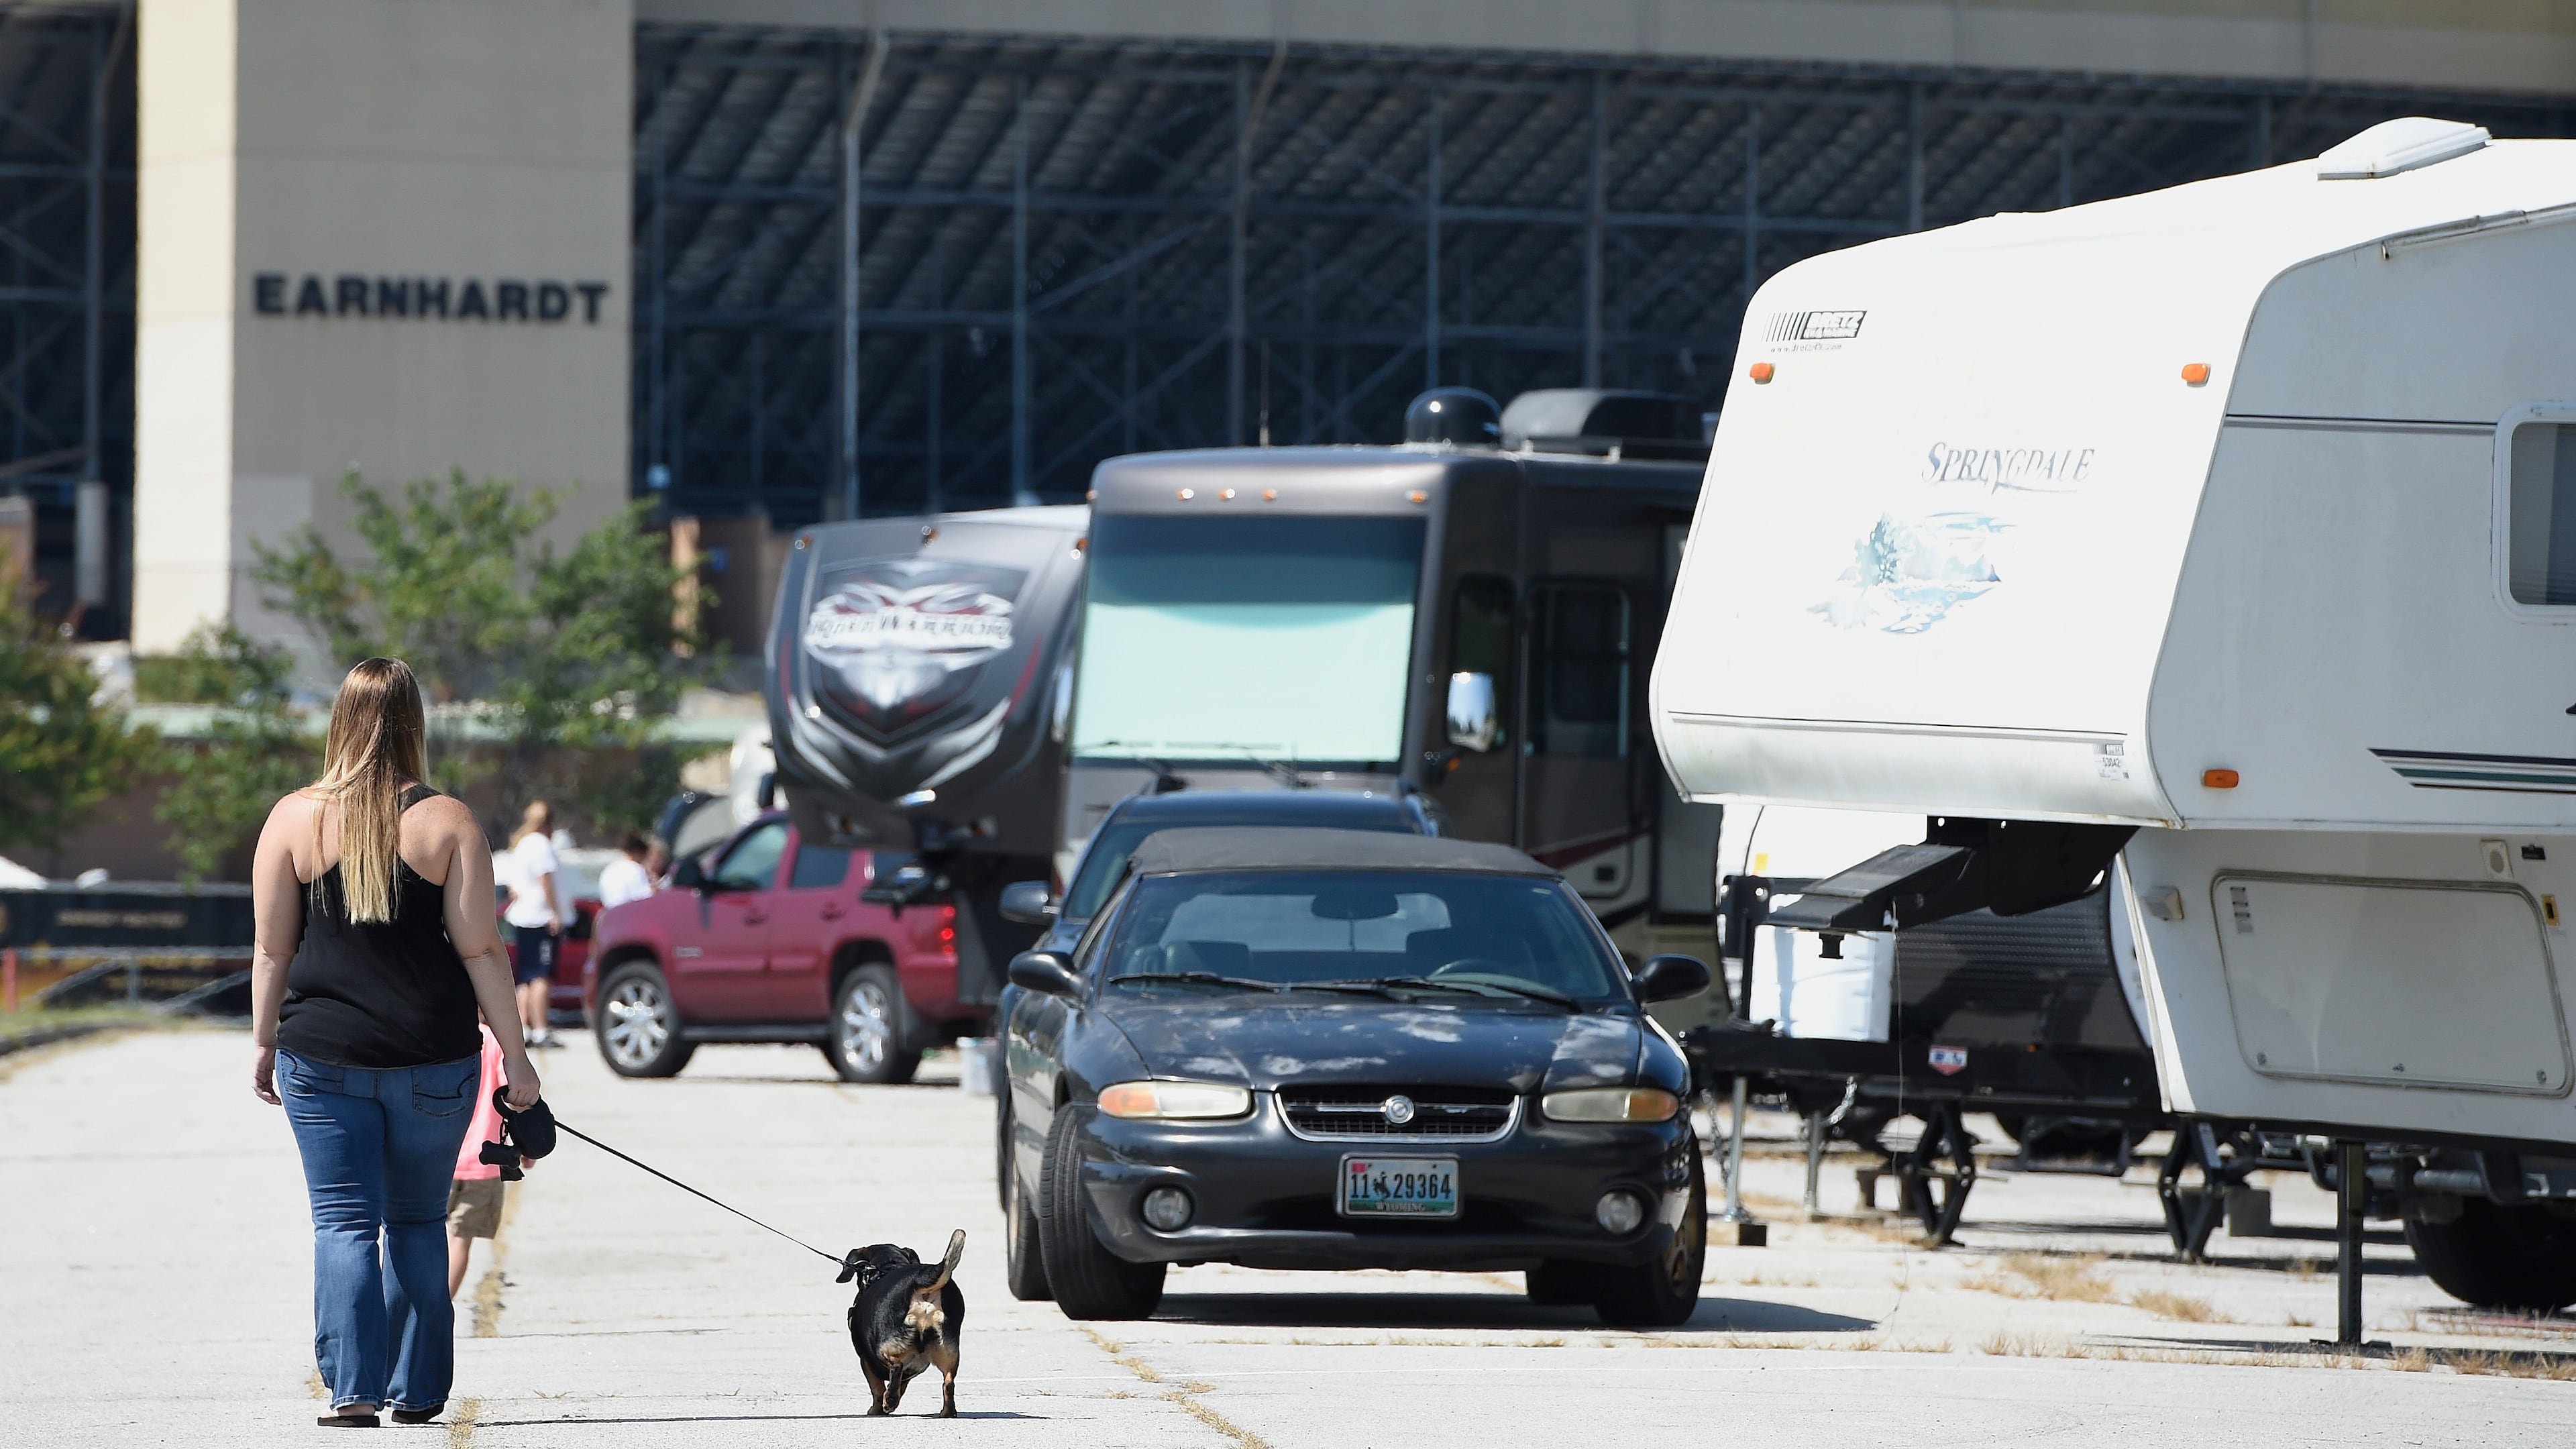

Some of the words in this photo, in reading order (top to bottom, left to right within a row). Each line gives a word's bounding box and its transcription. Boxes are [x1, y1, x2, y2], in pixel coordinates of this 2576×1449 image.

[254, 272, 609, 325] EARNHARDT
[1921, 441, 2095, 494] SPRINGDALE
[1352, 1174, 1369, 1199] 11
[1393, 1174, 1451, 1199] 29364
[1375, 1201, 1426, 1212] WYOMING
